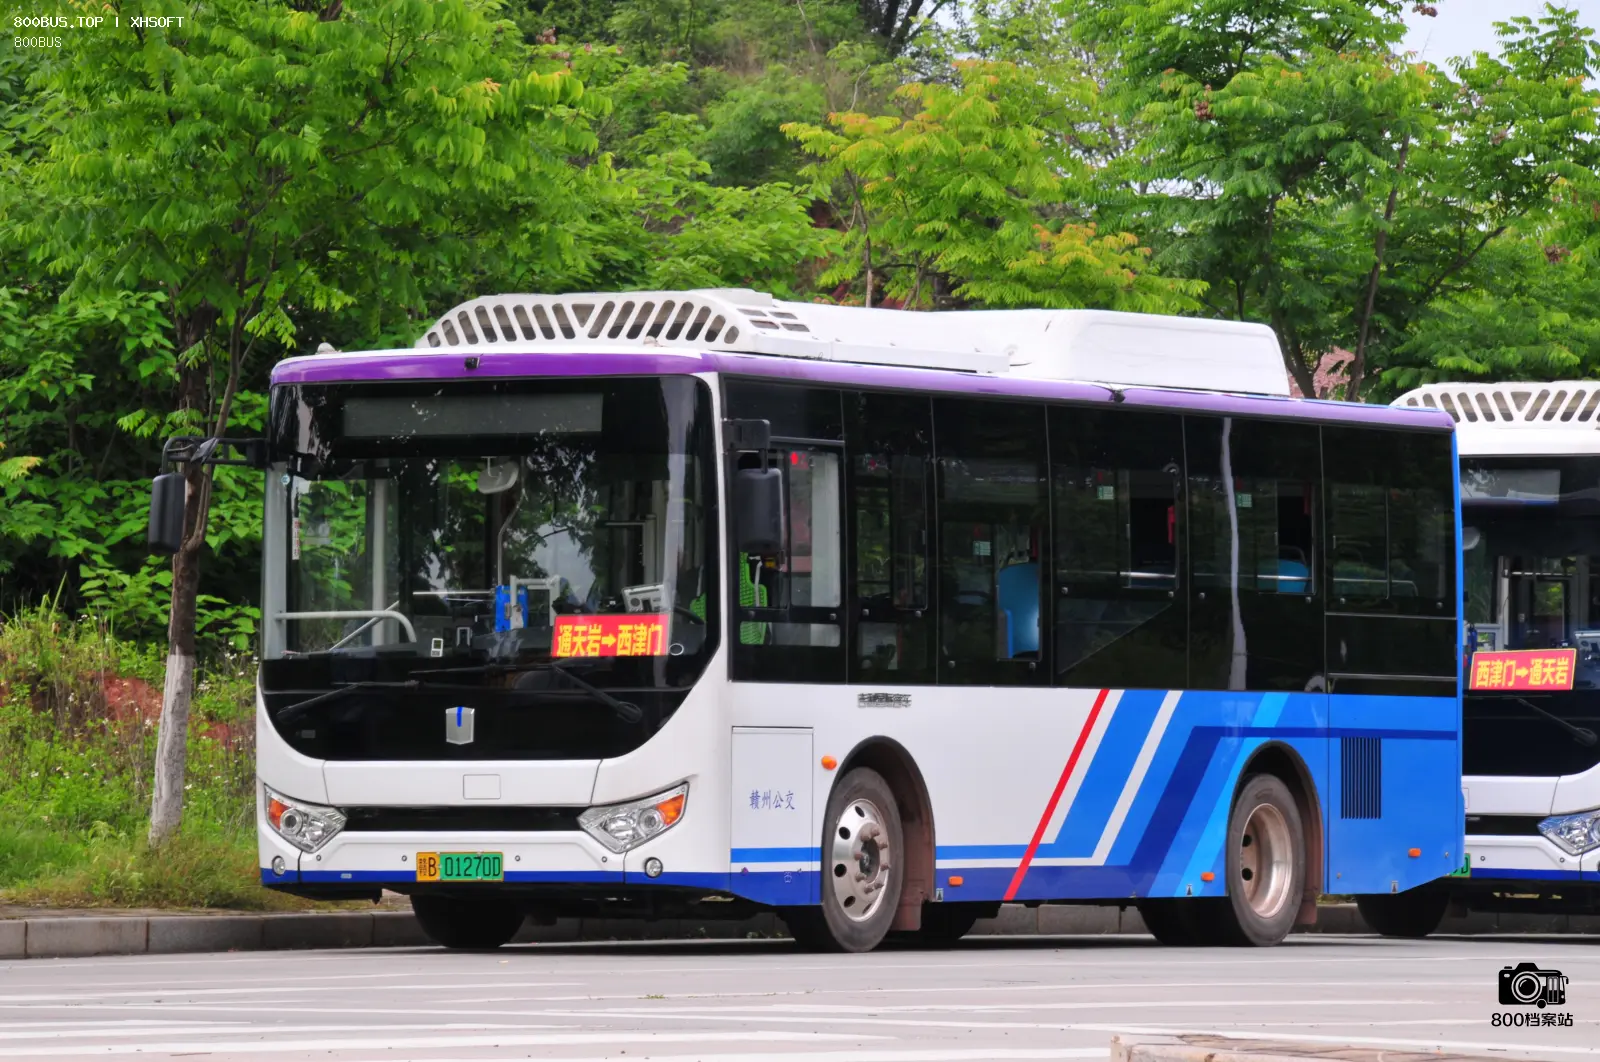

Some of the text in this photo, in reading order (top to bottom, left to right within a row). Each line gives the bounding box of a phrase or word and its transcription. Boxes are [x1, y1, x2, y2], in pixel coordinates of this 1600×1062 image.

[557, 622, 663, 657] 通天岩 西津门
[749, 788, 795, 810] 赣州公交
